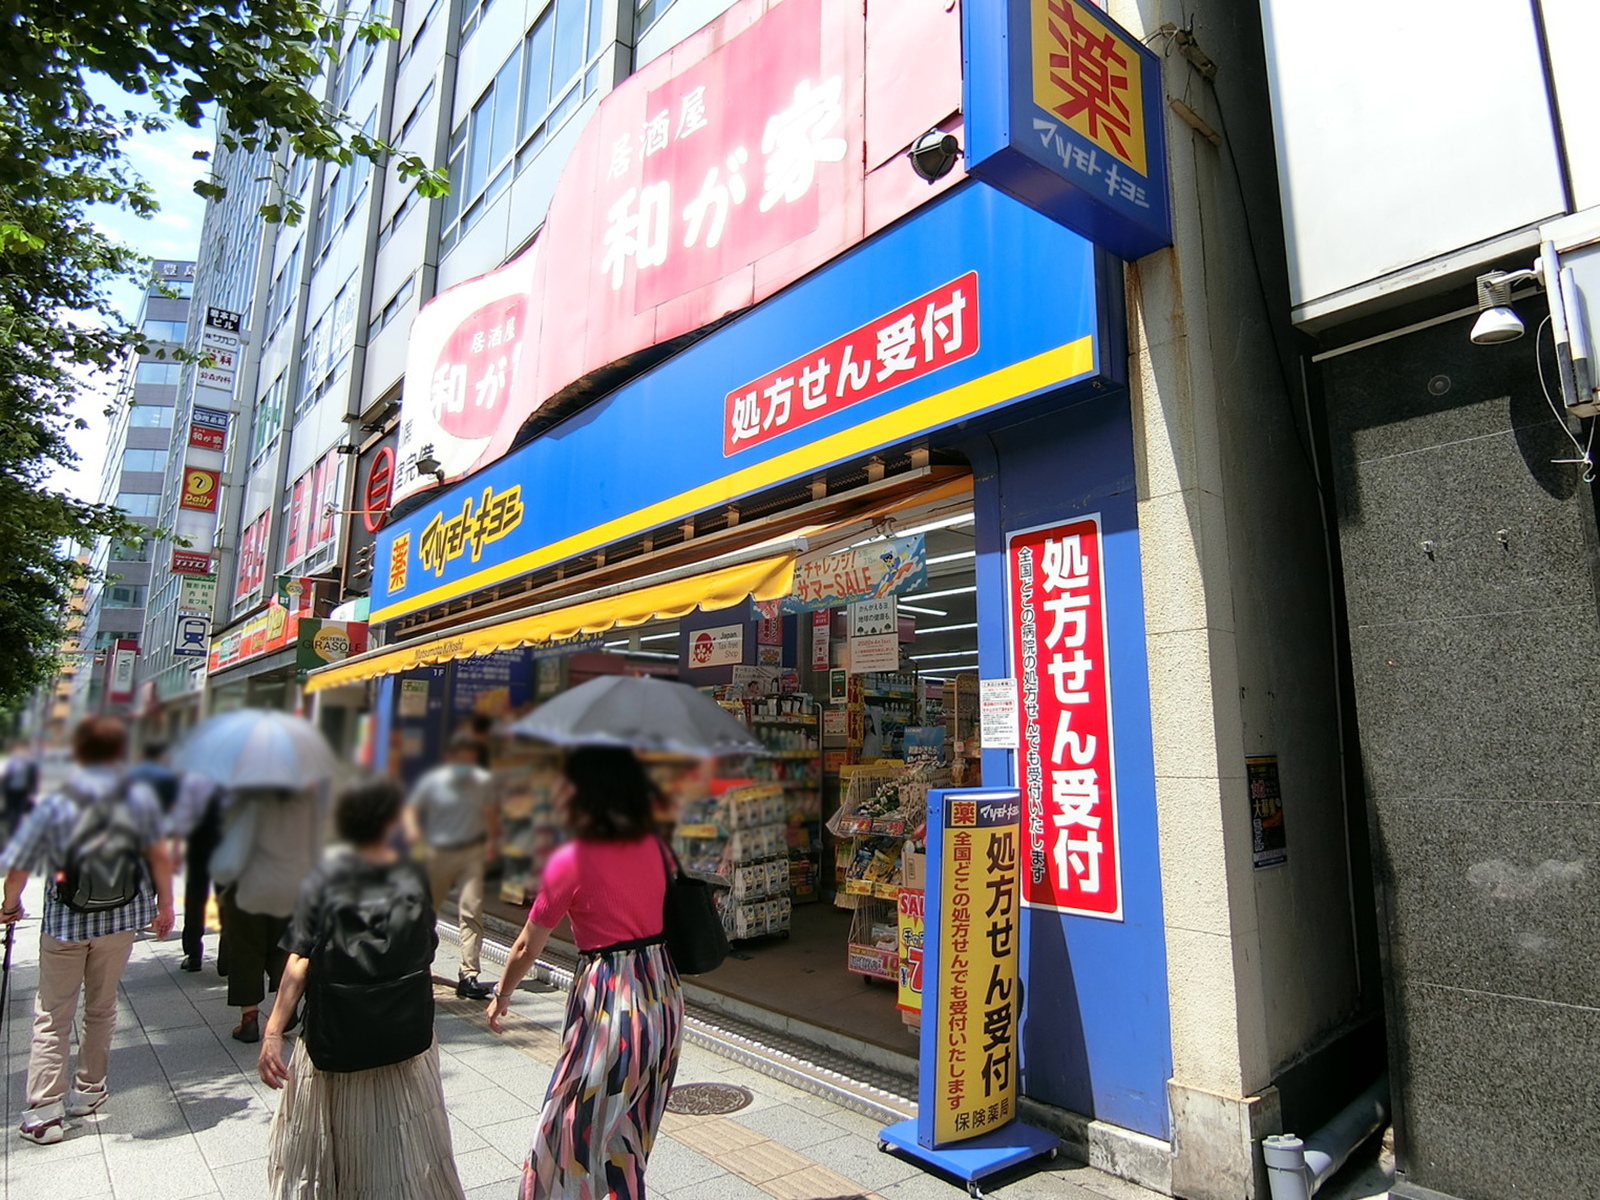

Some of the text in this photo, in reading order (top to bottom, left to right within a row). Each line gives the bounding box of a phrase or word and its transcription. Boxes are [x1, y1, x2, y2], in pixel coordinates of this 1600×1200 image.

[1047, 0, 1131, 163] 薬
[606, 85, 708, 182] 居酒屋
[1032, 117, 1150, 209] マツモトキヨシ
[601, 75, 848, 291] 和が家
[213, 319, 234, 330] ビル
[471, 317, 516, 354] 居酒屋
[731, 289, 966, 444] 処方せん受付
[430, 340, 523, 421] 和が
[184, 494, 213, 508] Daily
[420, 485, 524, 577] マツモトキヨシ
[390, 537, 408, 590] 薬
[797, 566, 873, 605] サマーSALE
[302, 640, 361, 652] GIRASOLE
[725, 650, 738, 659] Shop
[1017, 546, 1045, 884] 全国どこの病院の処方せんでも受付いたします
[1041, 534, 1103, 894] 処方せん受付
[953, 801, 975, 825] 薬
[947, 831, 973, 1111] 全国どこの処方せんでも受付いたします
[981, 832, 1016, 1098] 処方せん受付
[955, 1097, 1009, 1132] 保険薬局
